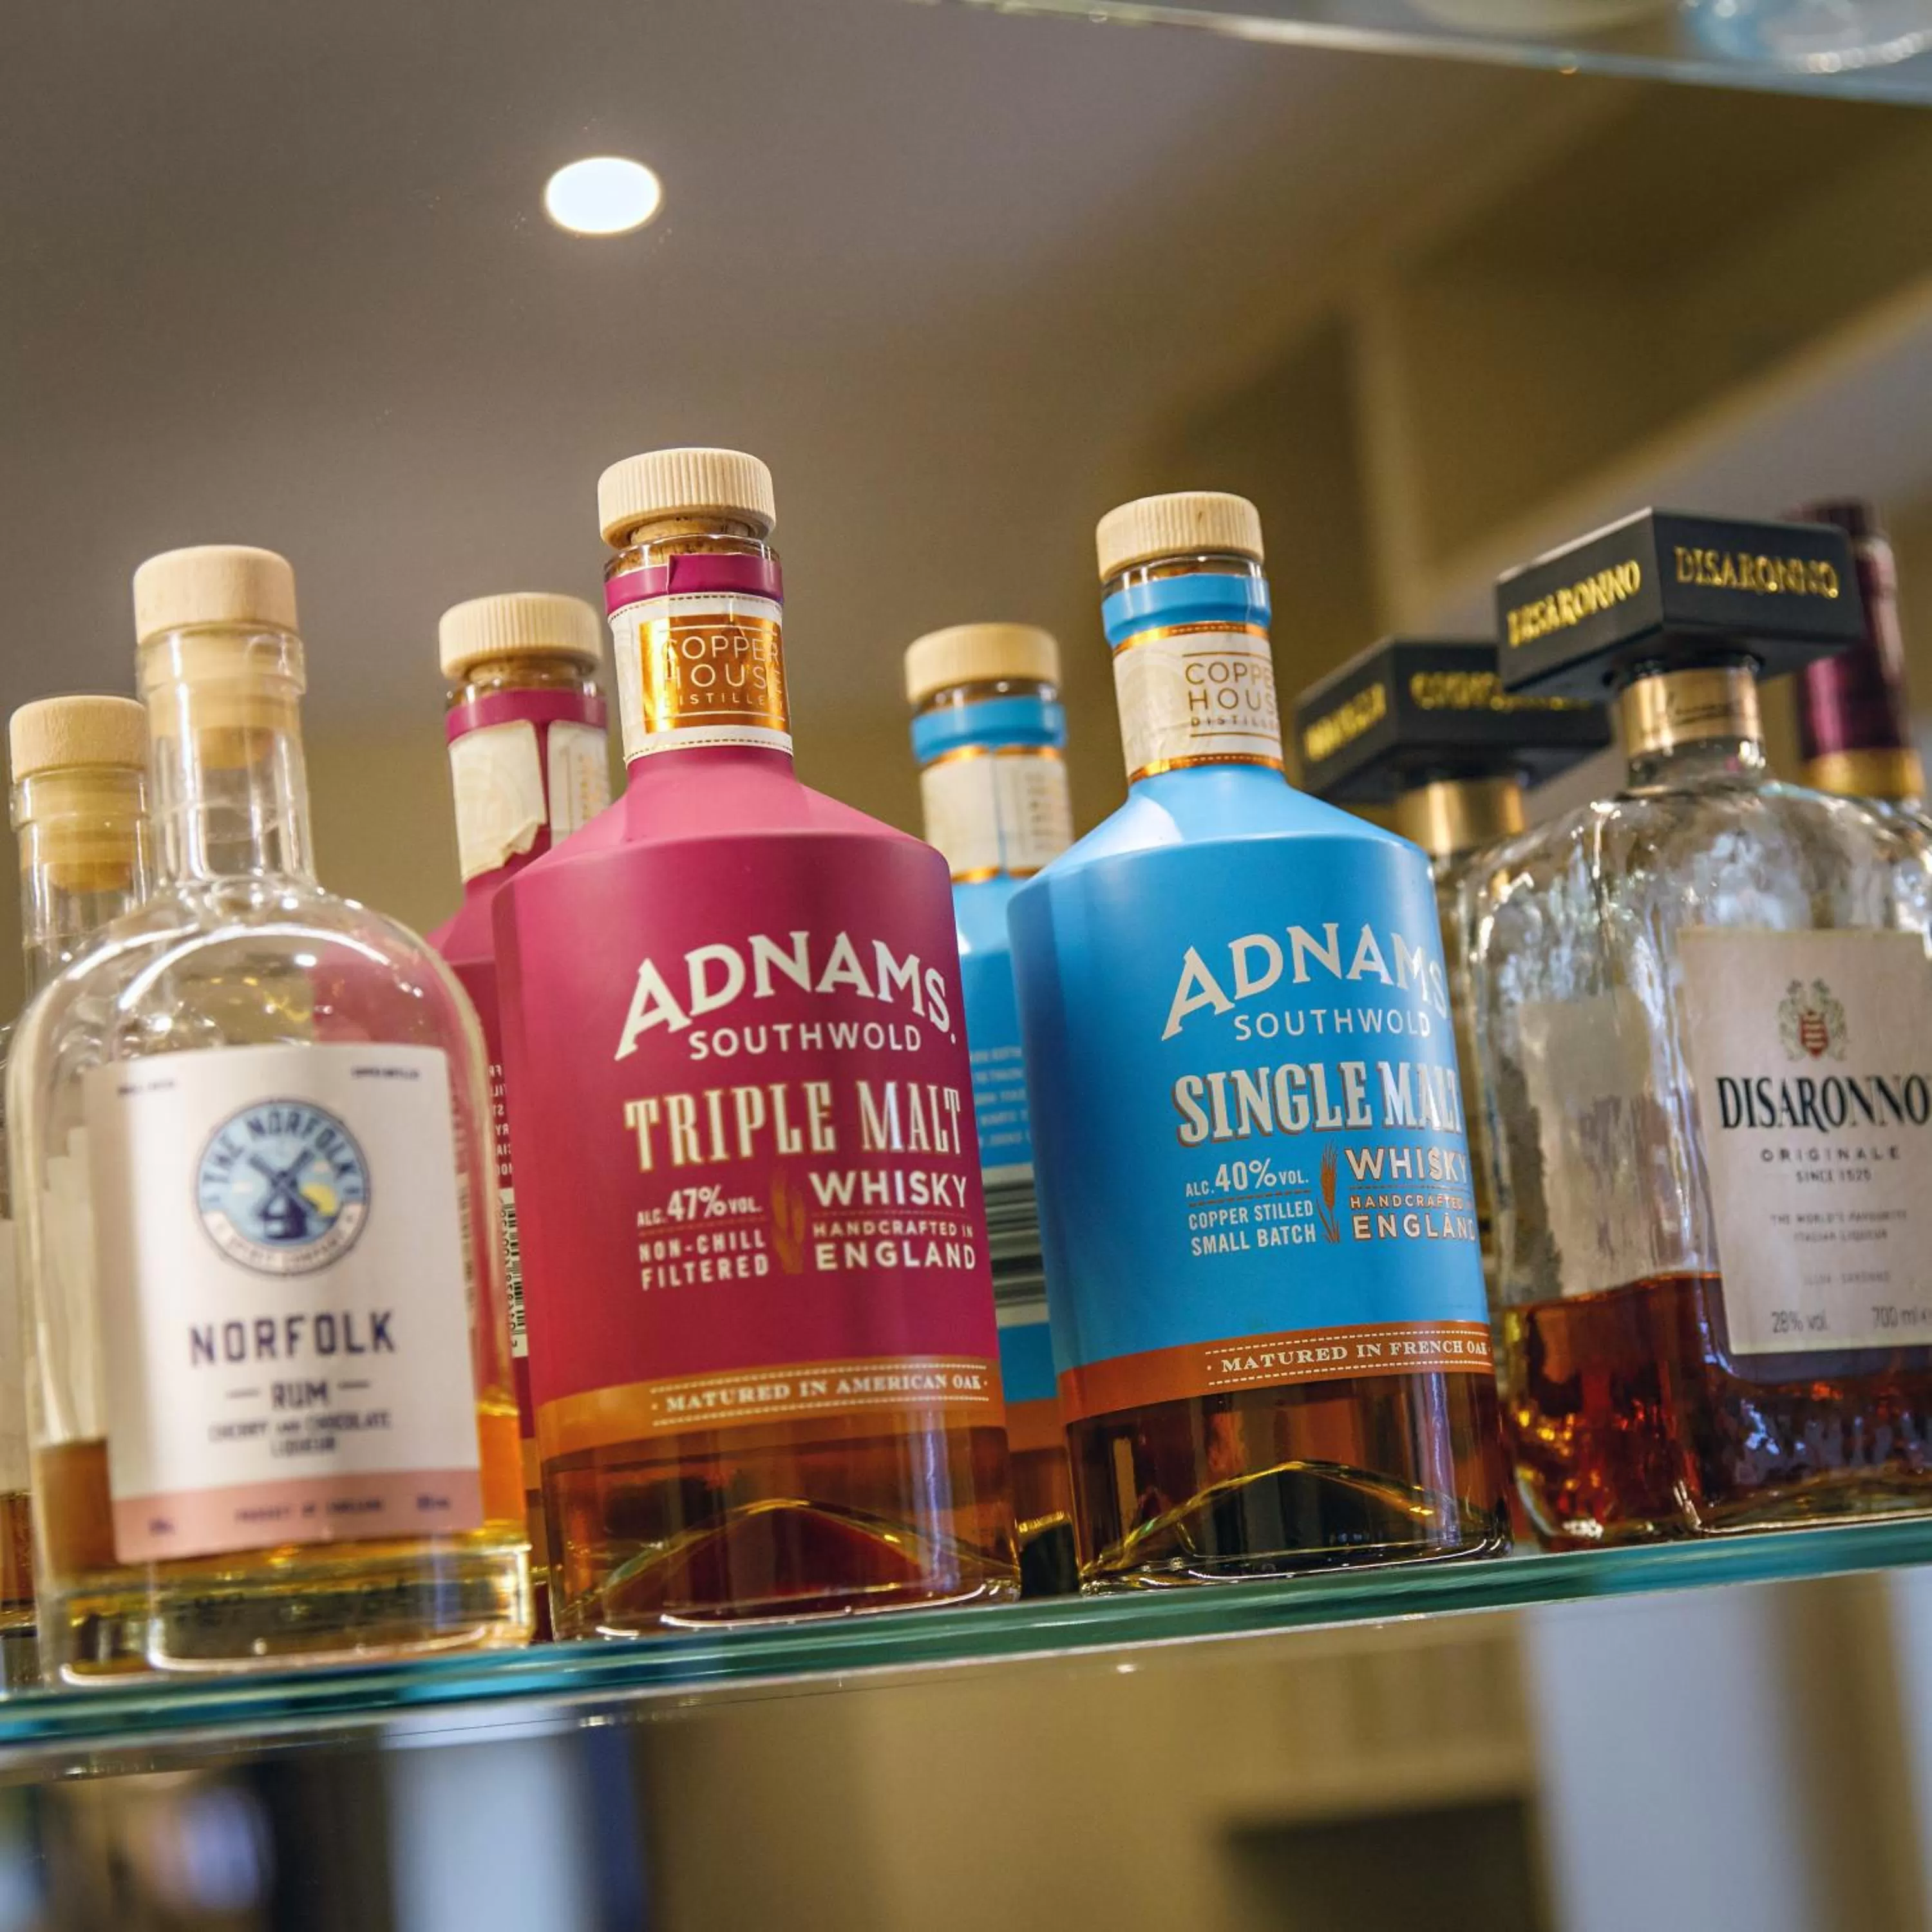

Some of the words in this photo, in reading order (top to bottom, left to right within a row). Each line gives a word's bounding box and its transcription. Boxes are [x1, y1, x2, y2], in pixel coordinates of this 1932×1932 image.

[1674, 545, 1839, 598] DISARONNO
[1507, 559, 1641, 648] DISARONNO
[1186, 661, 1273, 689] COPPE
[1188, 688, 1274, 715] HOUS
[615, 931, 956, 1061] ADNAMS.
[1162, 923, 1448, 1041] ADNAMS
[690, 1023, 921, 1060] SOUTHWOLD
[1235, 1009, 1430, 1041] SOUTHWOLD
[1171, 1061, 1373, 1147] SINGLE
[1716, 1075, 1929, 1133] DISARONNO
[246, 1109, 358, 1180] NORFOLK
[624, 1082, 836, 1172] TRIPLE
[855, 1081, 961, 1155] MALT
[1344, 1146, 1467, 1184] WHISKY
[1761, 1146, 1900, 1162] ORIGINALE
[809, 1170, 967, 1208] WHISKY
[1186, 1181, 1215, 1197] ALC.
[1215, 1158, 1276, 1193] 40%
[1278, 1169, 1309, 1186] VOL.
[637, 1208, 667, 1228] ALC.
[667, 1184, 727, 1222] 47%
[728, 1197, 763, 1215] VOL.
[1188, 1206, 1251, 1231] COPPER
[1254, 1200, 1313, 1222] STILLED
[639, 1228, 766, 1264] NON-CHILL
[813, 1220, 957, 1238] HANDCRAFTED
[962, 1225, 974, 1238] IN
[1191, 1231, 1250, 1257] SMALL
[1257, 1223, 1316, 1248] BATCH
[641, 1253, 770, 1291] FILTERED
[815, 1240, 976, 1271] ENGLAND
[1871, 1305, 1899, 1328] 700
[191, 1310, 395, 1367] NORFOLK
[1221, 1345, 1348, 1373] MATURED
[1356, 1342, 1381, 1359] IN
[1390, 1340, 1463, 1356] FRENCH
[272, 1380, 328, 1409] RUM
[667, 1384, 791, 1412] MATURED
[799, 1379, 827, 1397] IN
[836, 1374, 947, 1395] AMERICAN
[952, 1373, 981, 1390] OAK
